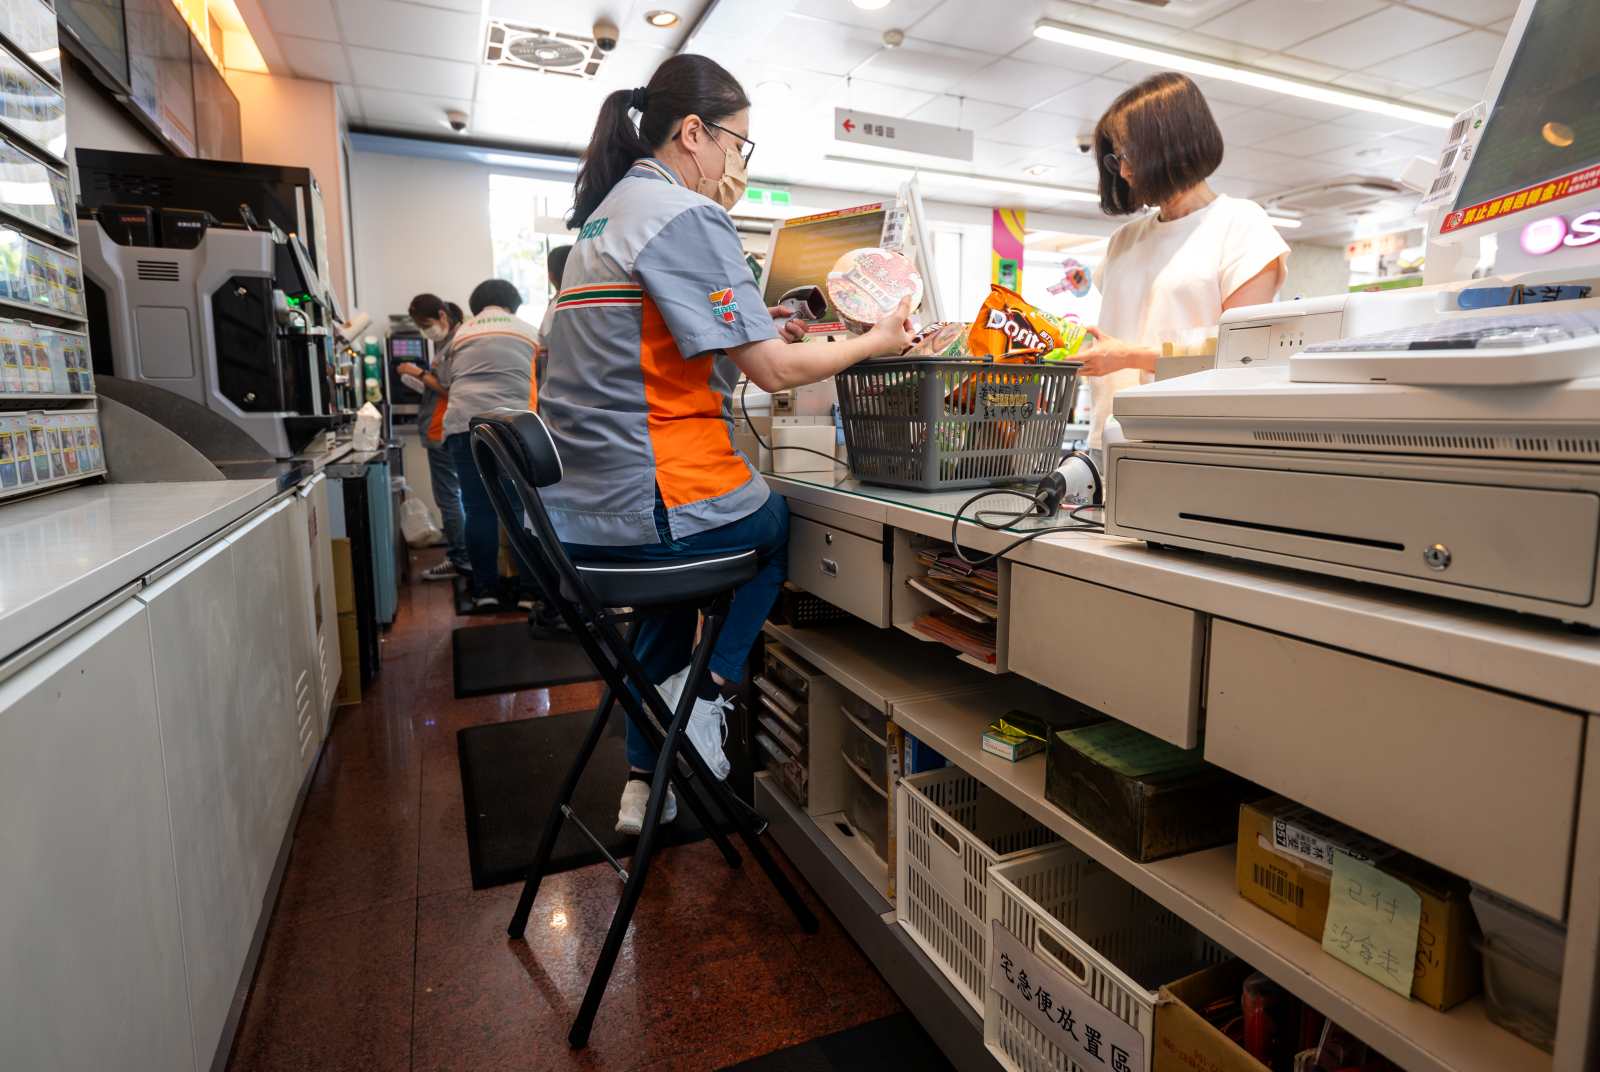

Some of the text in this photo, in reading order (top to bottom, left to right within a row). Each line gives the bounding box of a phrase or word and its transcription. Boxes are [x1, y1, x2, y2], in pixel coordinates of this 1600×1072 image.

[1000, 952, 1132, 1072] 宅急便放置區
